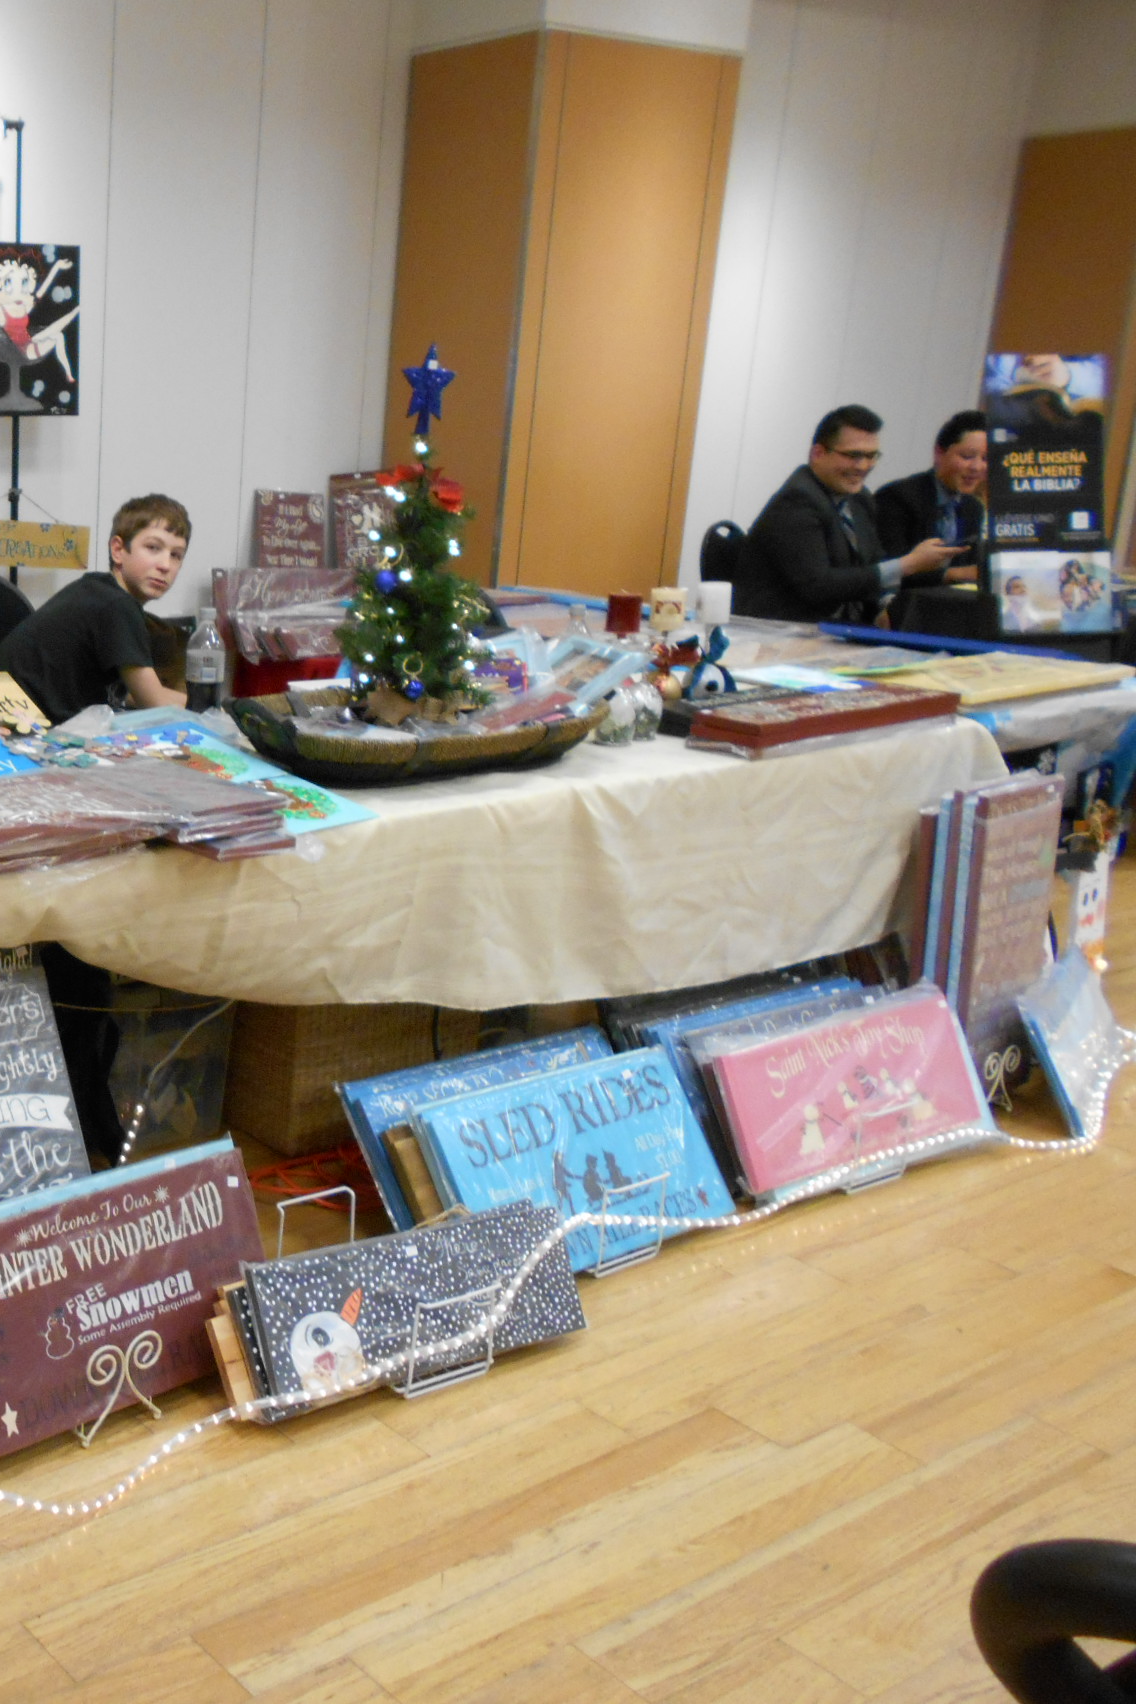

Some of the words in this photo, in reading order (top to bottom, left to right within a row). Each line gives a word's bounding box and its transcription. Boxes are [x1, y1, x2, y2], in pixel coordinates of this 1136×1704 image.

[1010, 465, 1082, 478] REALMENTE
[1013, 479, 1031, 491] LA
[1033, 478, 1081, 491] BIBLIA?
[995, 523, 1035, 537] GRATIS
[766, 1047, 808, 1099] Saint
[805, 1028, 850, 1068] Nick's
[883, 1015, 930, 1061] Shop
[459, 1101, 557, 1169] SLED
[558, 1065, 671, 1135] RIDES
[2, 1130, 73, 1179] the
[30, 1210, 100, 1242] Welcome
[99, 1200, 119, 1222] To
[122, 1193, 153, 1213] Our
[69, 1180, 224, 1272] WONDERLAND
[65, 1282, 107, 1314] FREE
[77, 1328, 107, 1347] Some
[109, 1309, 156, 1333] Assembly
[157, 1291, 203, 1317] Required
